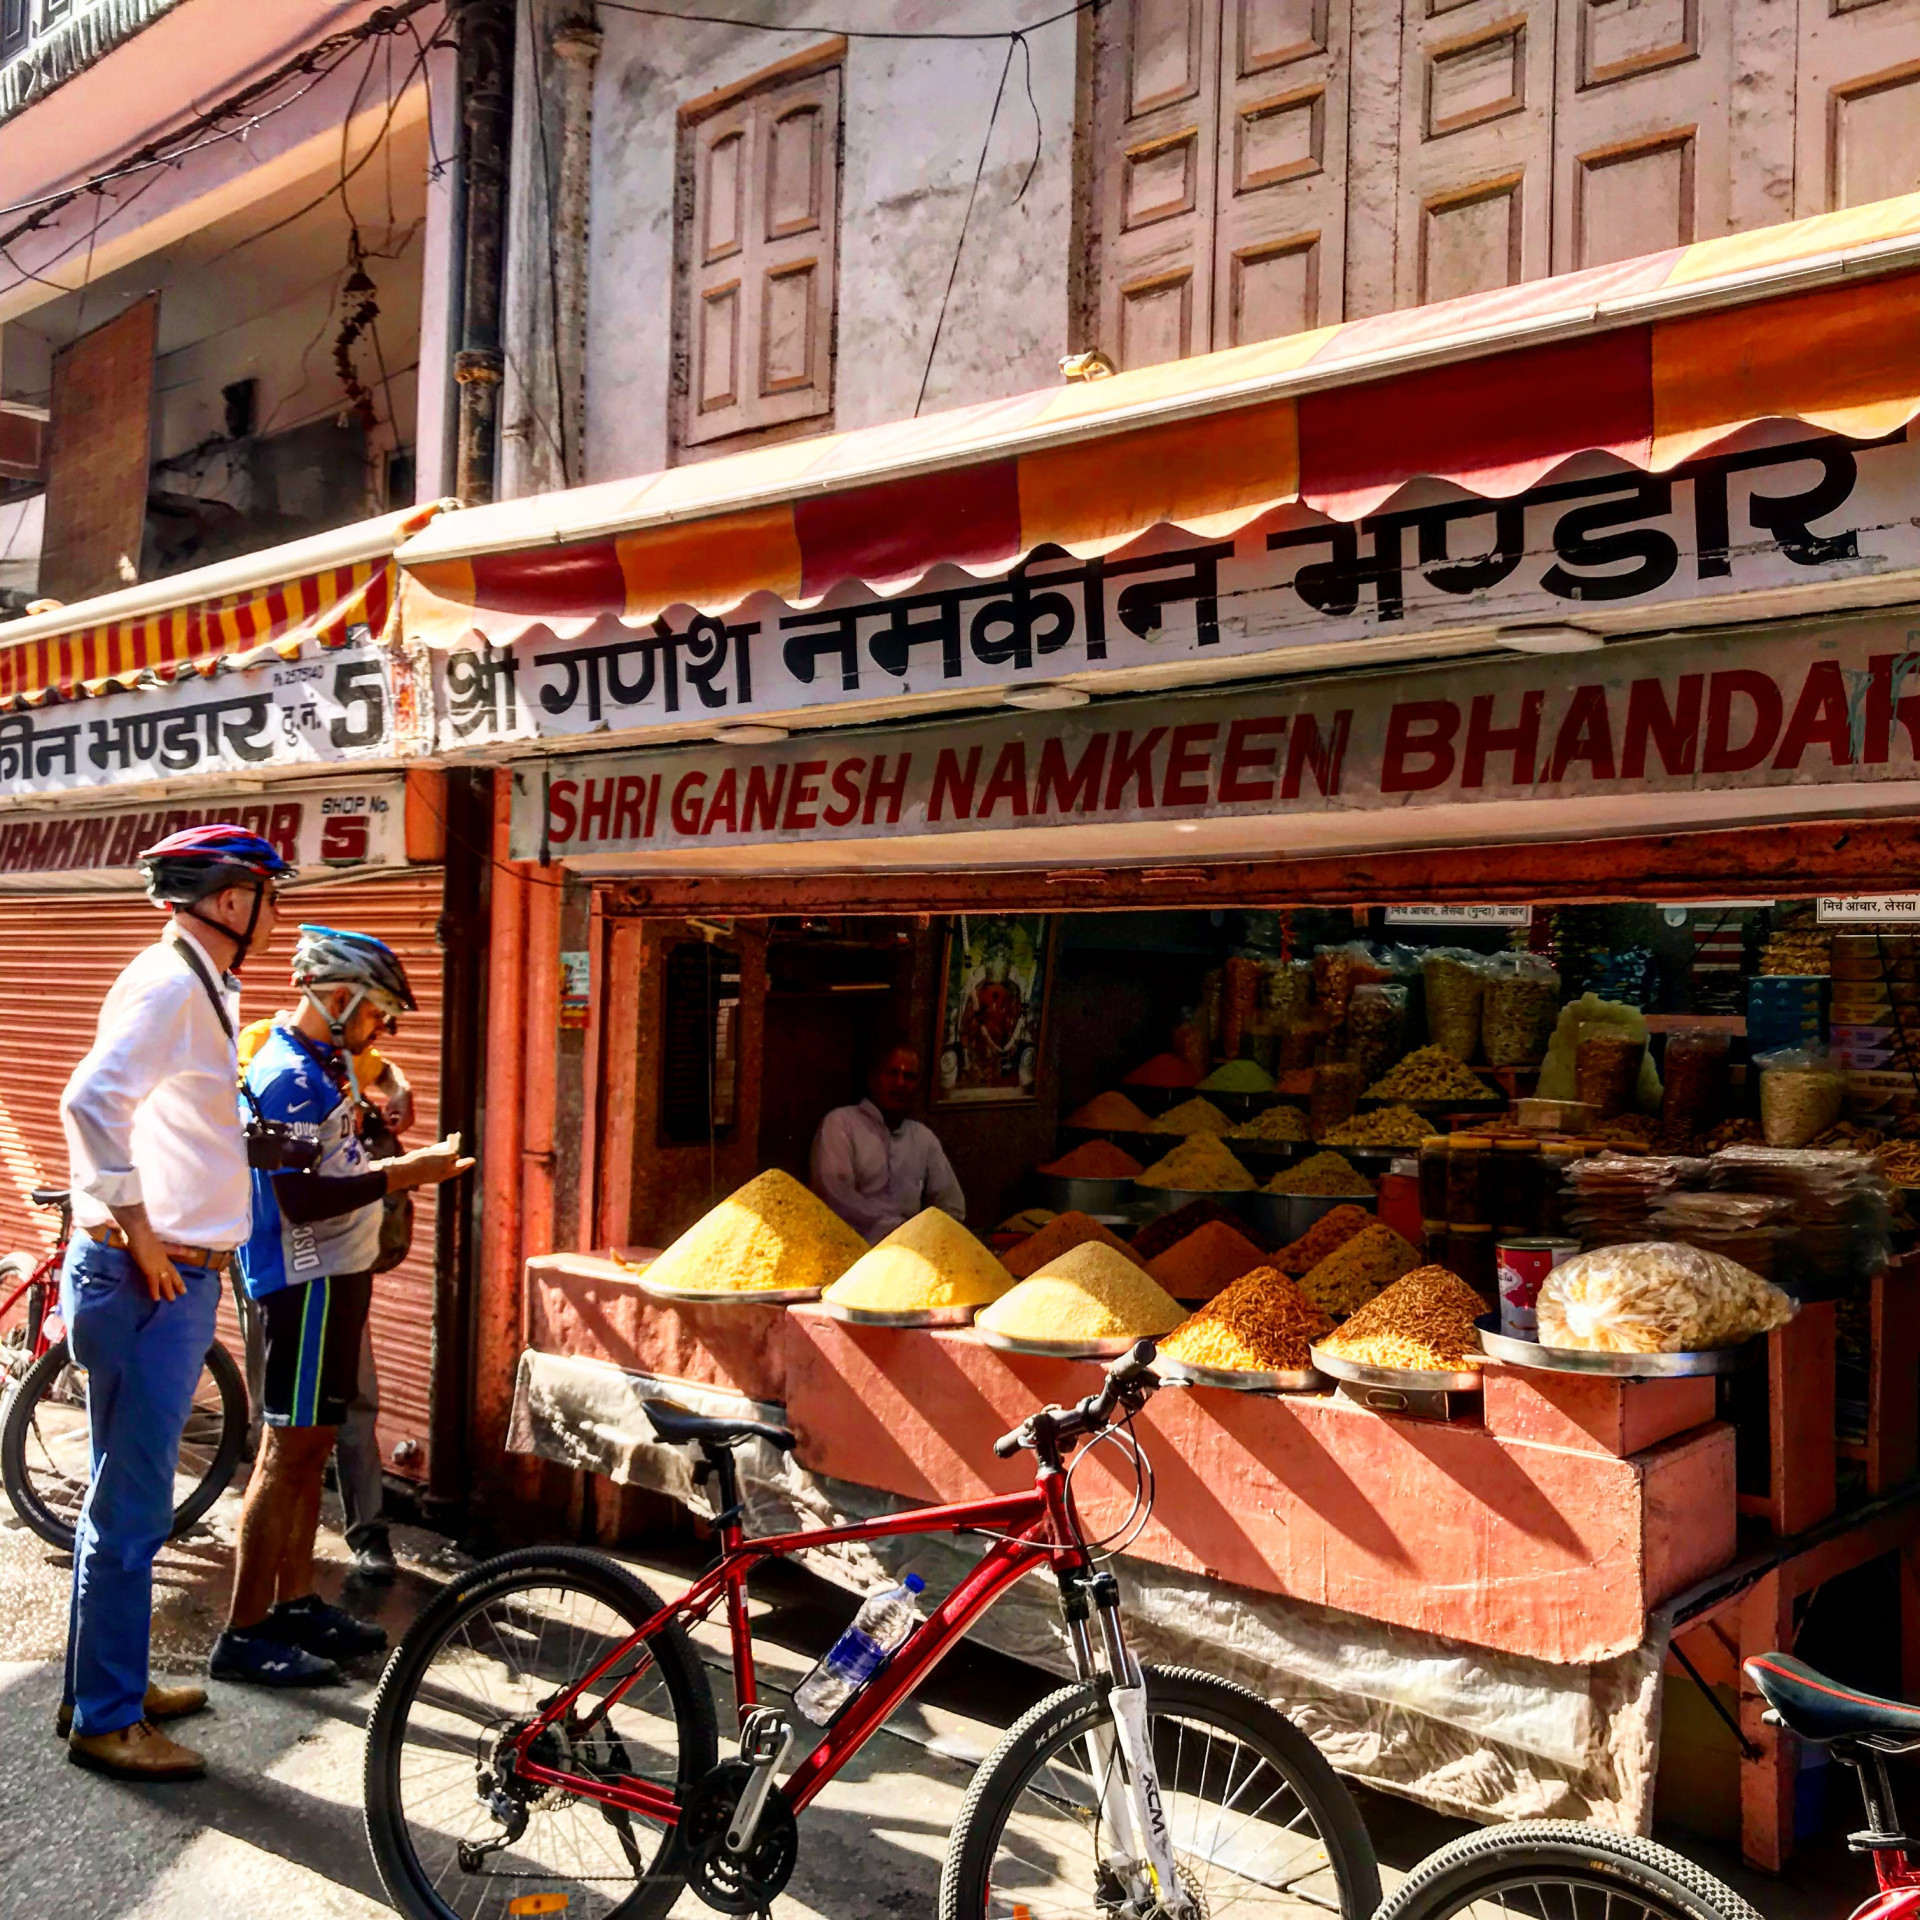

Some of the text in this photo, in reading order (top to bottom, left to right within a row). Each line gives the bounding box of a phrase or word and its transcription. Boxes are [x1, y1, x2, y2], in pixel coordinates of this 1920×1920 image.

[534, 612, 761, 722] गणेश
[779, 541, 1235, 691] नमकीन
[1267, 426, 1907, 622] भण्डार
[88, 692, 274, 770] भण्डार
[330, 659, 383, 749] 5
[548, 651, 1920, 843] SHRI GANESH NAMKEEN BHANDAR
[321, 796, 367, 815] SHOP
[320, 815, 371, 868] 5
[1884, 897, 1917, 912] लेसवा
[1034, 1700, 1100, 1750] KENDA
